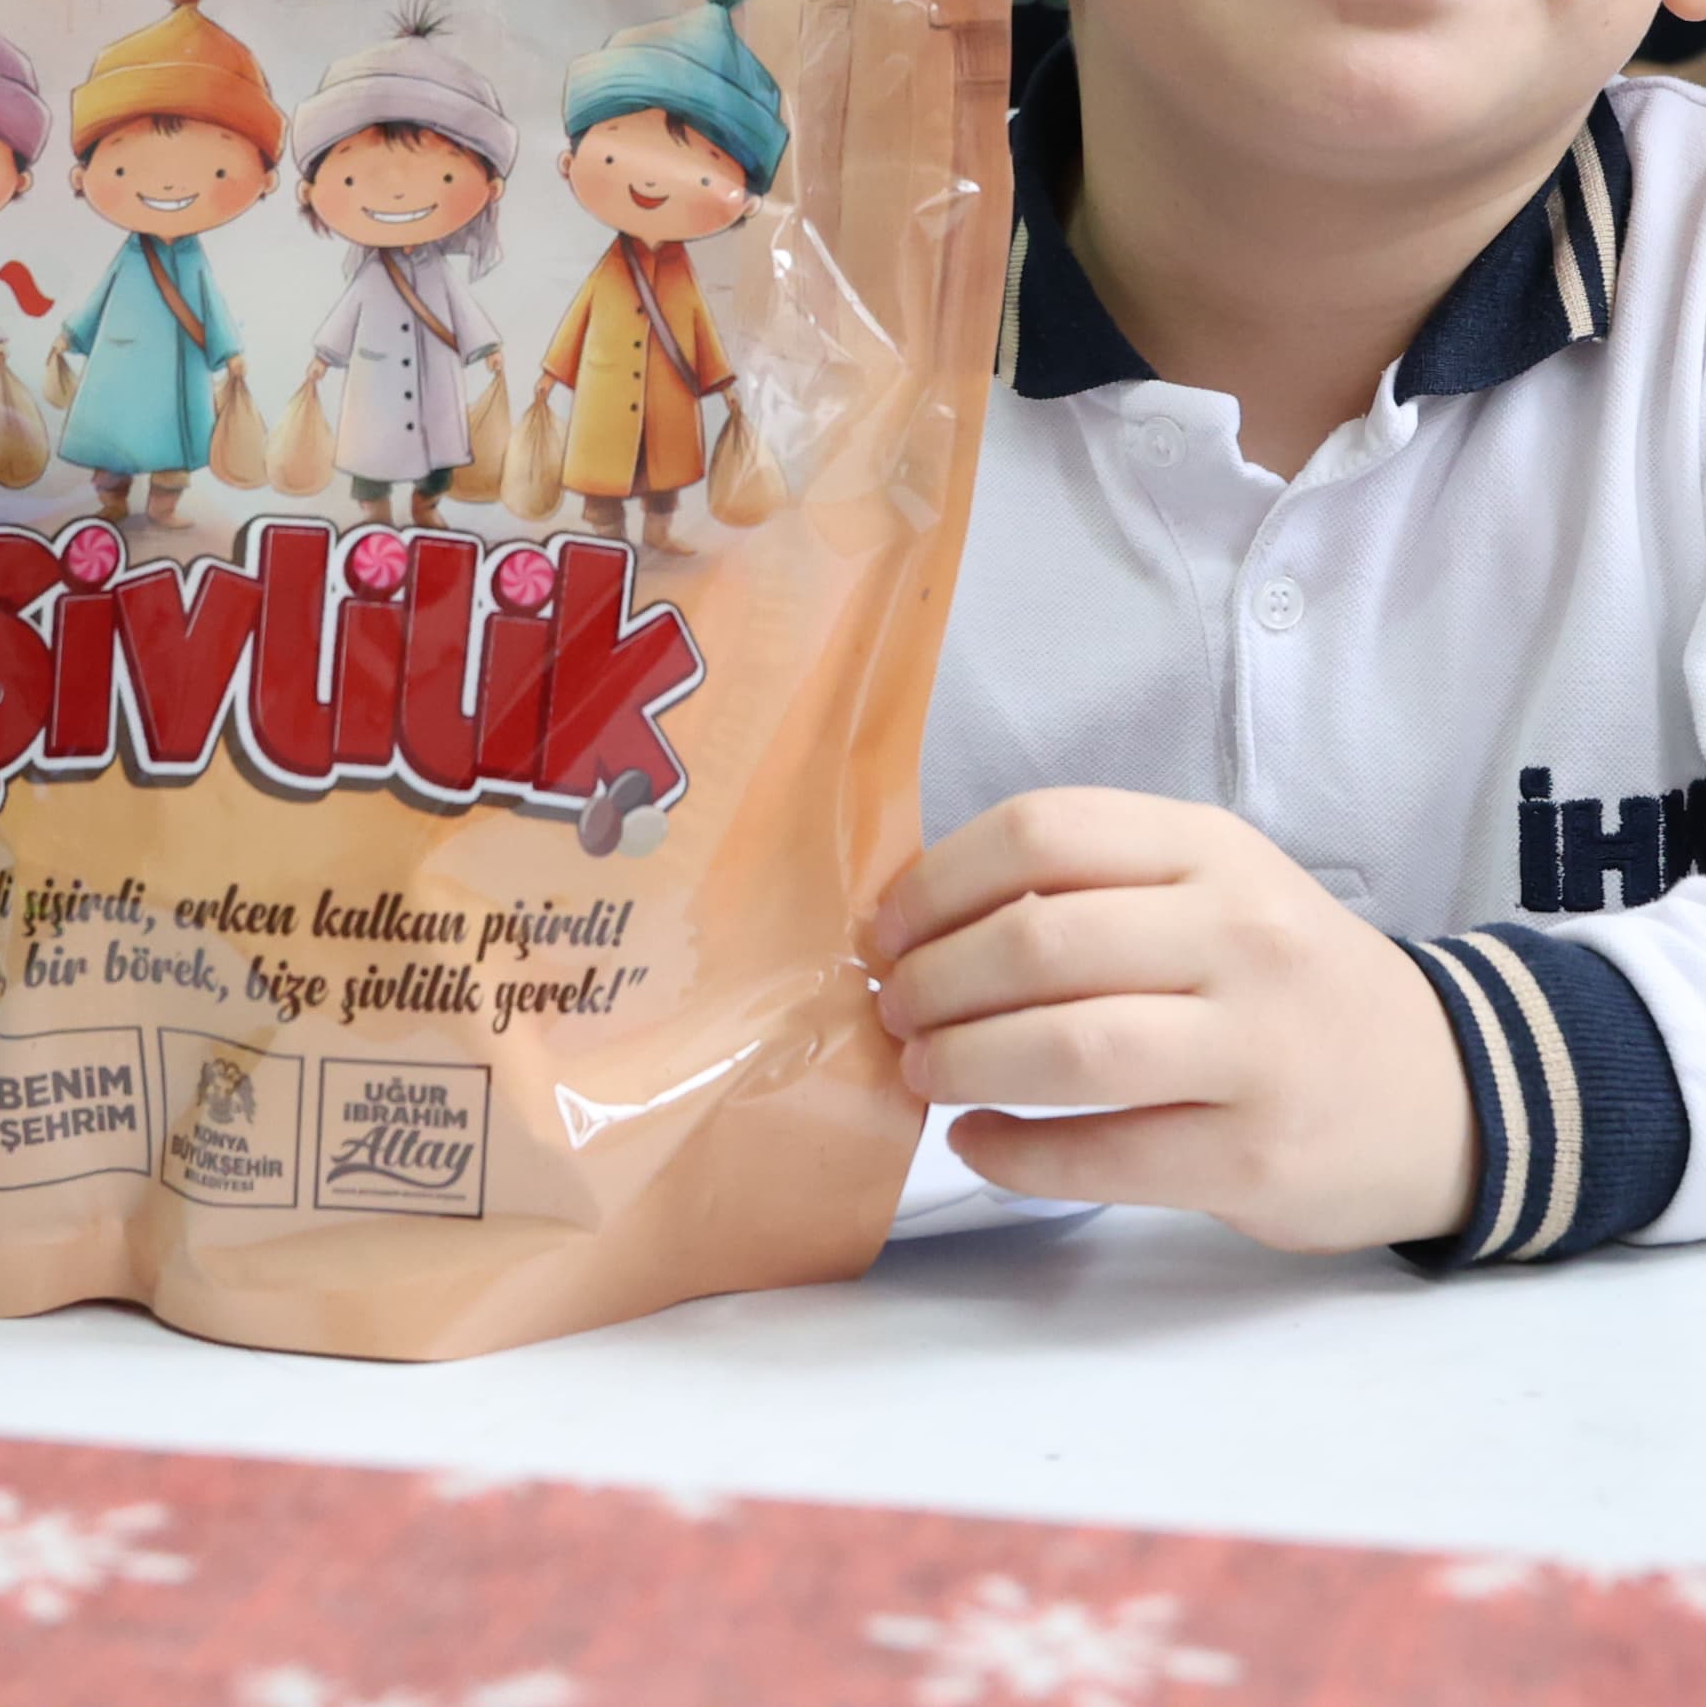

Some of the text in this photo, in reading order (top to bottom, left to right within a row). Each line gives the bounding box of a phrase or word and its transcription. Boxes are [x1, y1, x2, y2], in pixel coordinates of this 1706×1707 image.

[22, 877, 156, 937] şişirdi,
[175, 884, 299, 936] erken
[312, 888, 470, 945] kalkan
[476, 898, 634, 963] pişirdi!
[23, 941, 89, 989] bir
[104, 939, 230, 1002] börek,
[246, 955, 329, 1024] bize
[339, 962, 481, 1026] şivlilik
[342, 1101, 469, 1130] İBRAHİM
[363, 1077, 449, 1107] UĞUR
[326, 1125, 476, 1189] Altay
